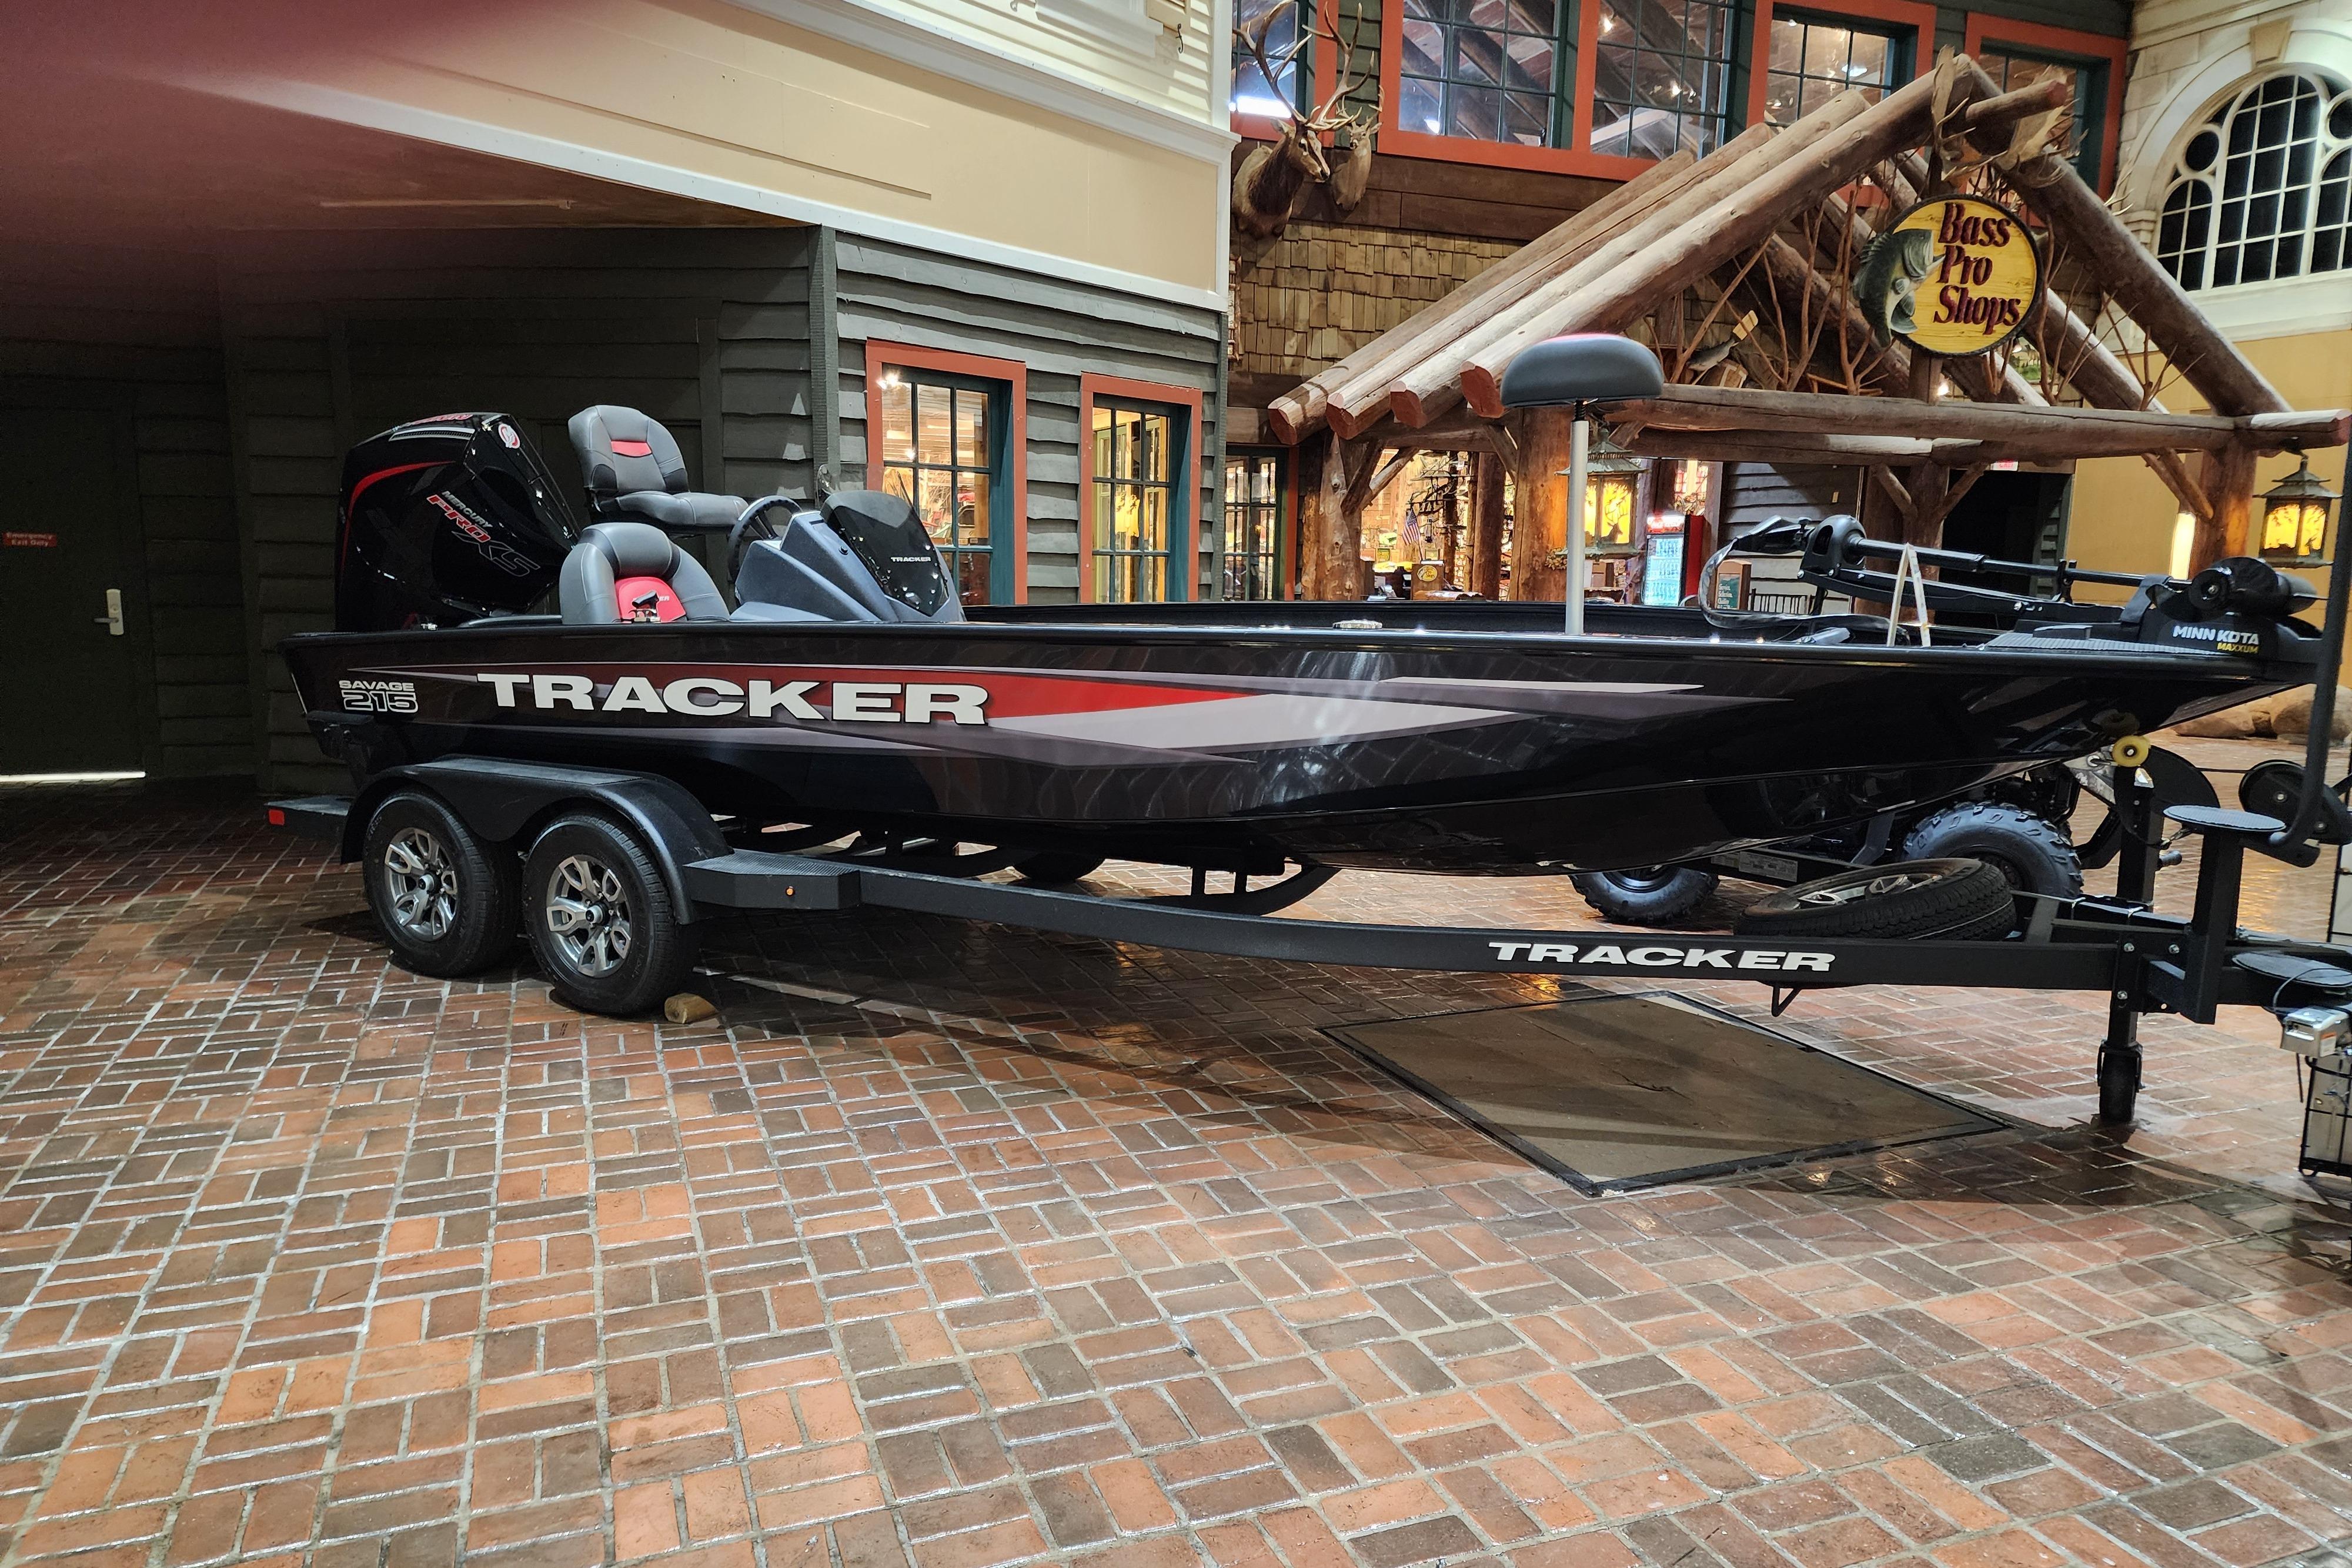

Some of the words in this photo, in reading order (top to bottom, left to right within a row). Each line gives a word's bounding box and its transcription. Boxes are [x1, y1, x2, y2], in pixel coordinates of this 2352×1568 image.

[1938, 202, 2012, 247] Bass
[1936, 245, 1993, 286] Pro
[1933, 285, 2022, 335] Shops
[426, 494, 491, 543] PRO
[442, 490, 493, 528] MERCURY
[451, 524, 541, 577] XS
[2173, 625, 2216, 641] MINN
[2216, 630, 2259, 645] KOTA
[2217, 642, 2259, 653] MAXXUM
[339, 680, 415, 691] SAVAGE
[341, 690, 419, 713] 215
[476, 673, 988, 725] TRACKER
[1488, 942, 1836, 971] TRACKER
